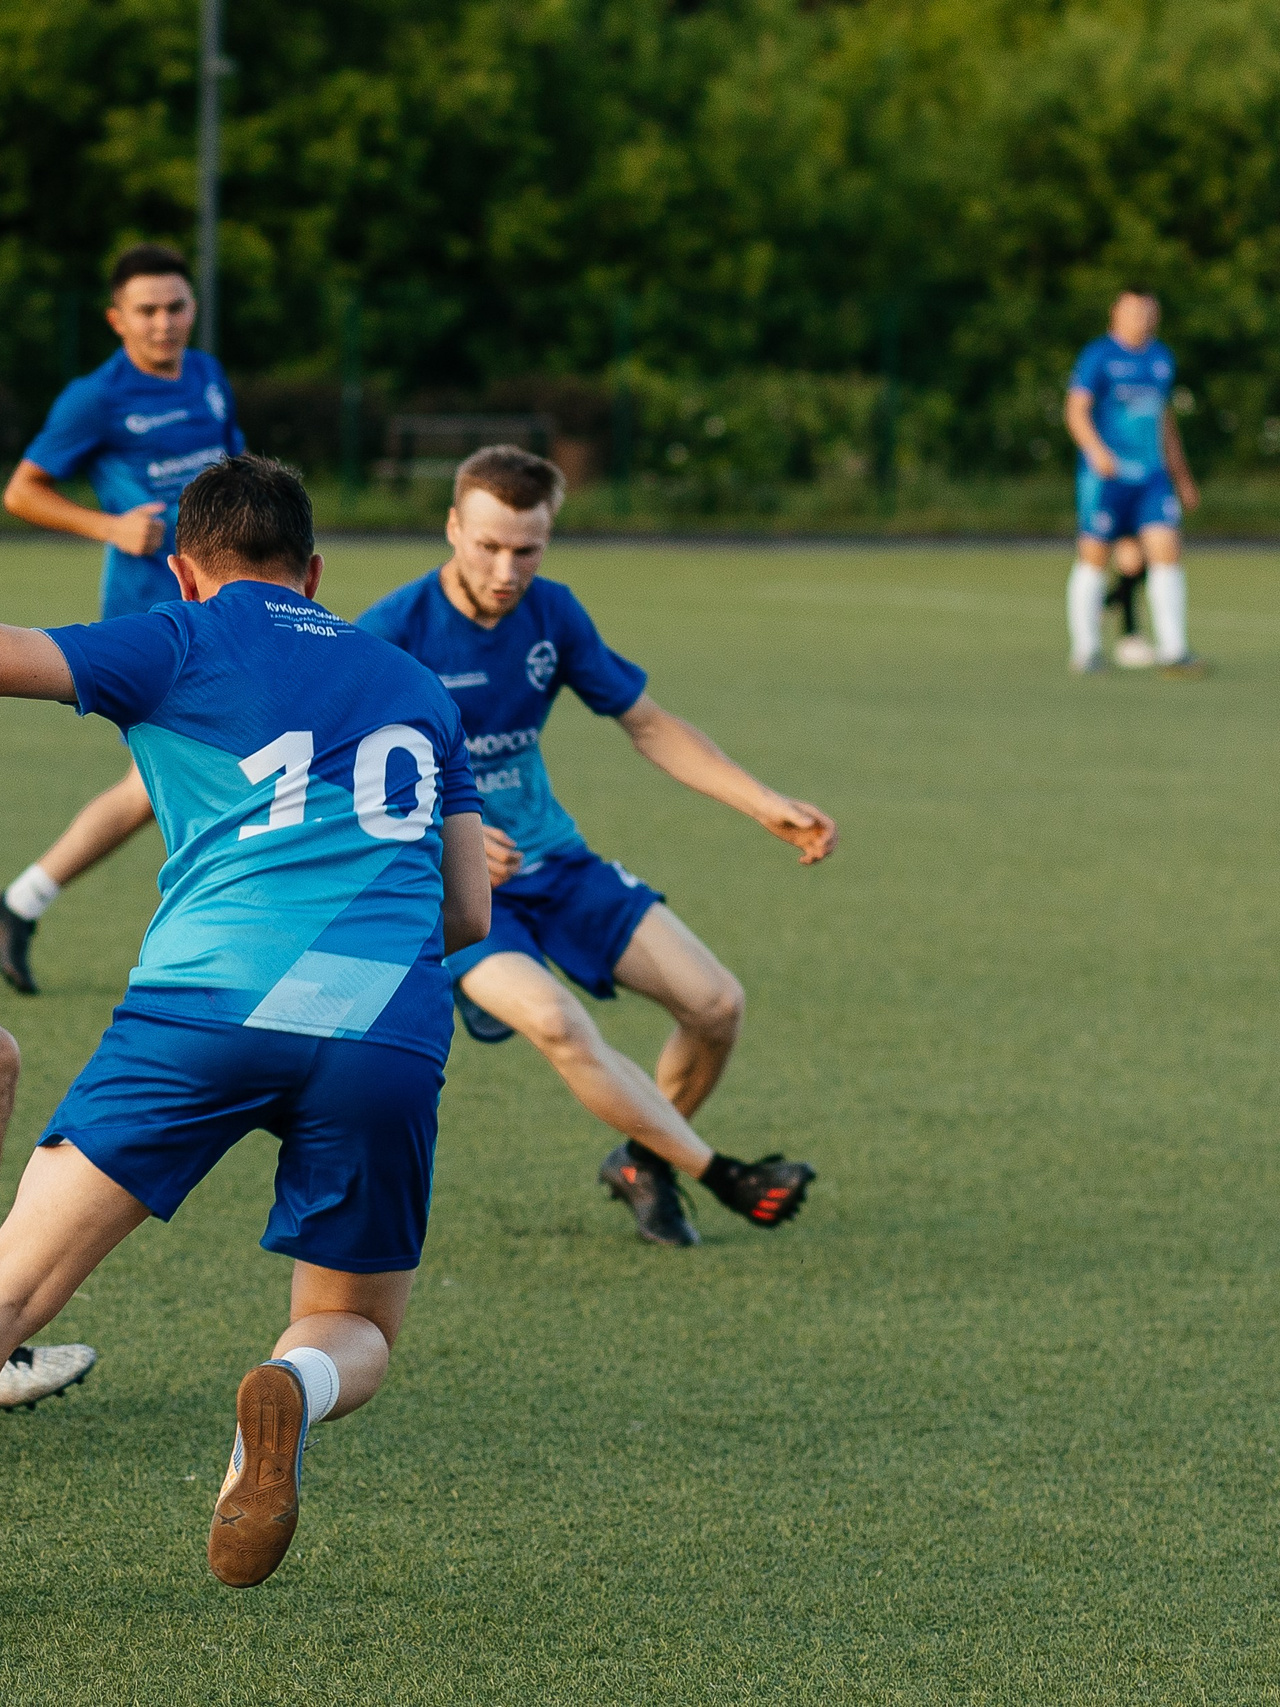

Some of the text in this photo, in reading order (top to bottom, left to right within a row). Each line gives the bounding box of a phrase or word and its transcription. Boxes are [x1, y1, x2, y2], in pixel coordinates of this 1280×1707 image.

[264, 600, 344, 622] КУКМОРСКИ
[293, 622, 338, 638] ЗАВОД
[237, 723, 440, 842] 10
